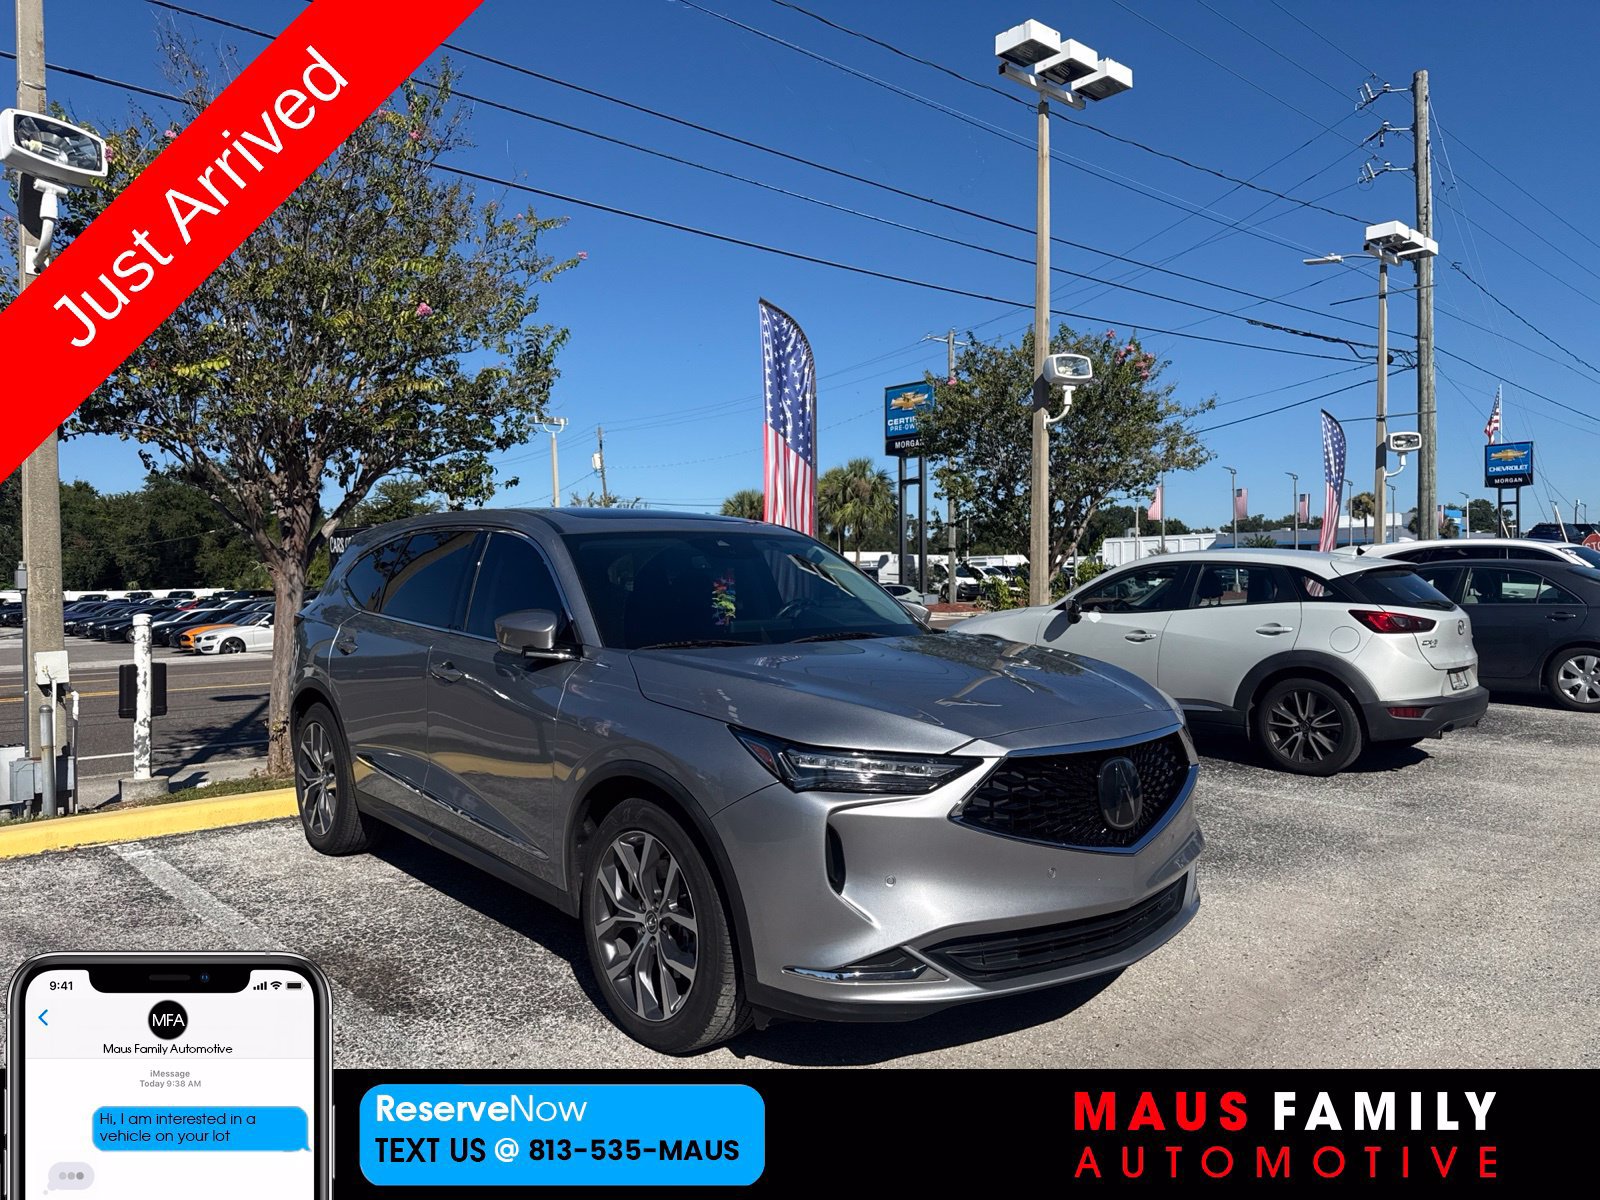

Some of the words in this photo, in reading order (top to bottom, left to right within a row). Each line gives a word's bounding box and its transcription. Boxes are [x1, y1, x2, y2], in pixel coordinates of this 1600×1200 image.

[888, 416, 917, 426] CERTIF
[889, 423, 915, 431] PRE-OW
[1488, 464, 1528, 472] CHEVROLET
[330, 536, 344, 553] CARS
